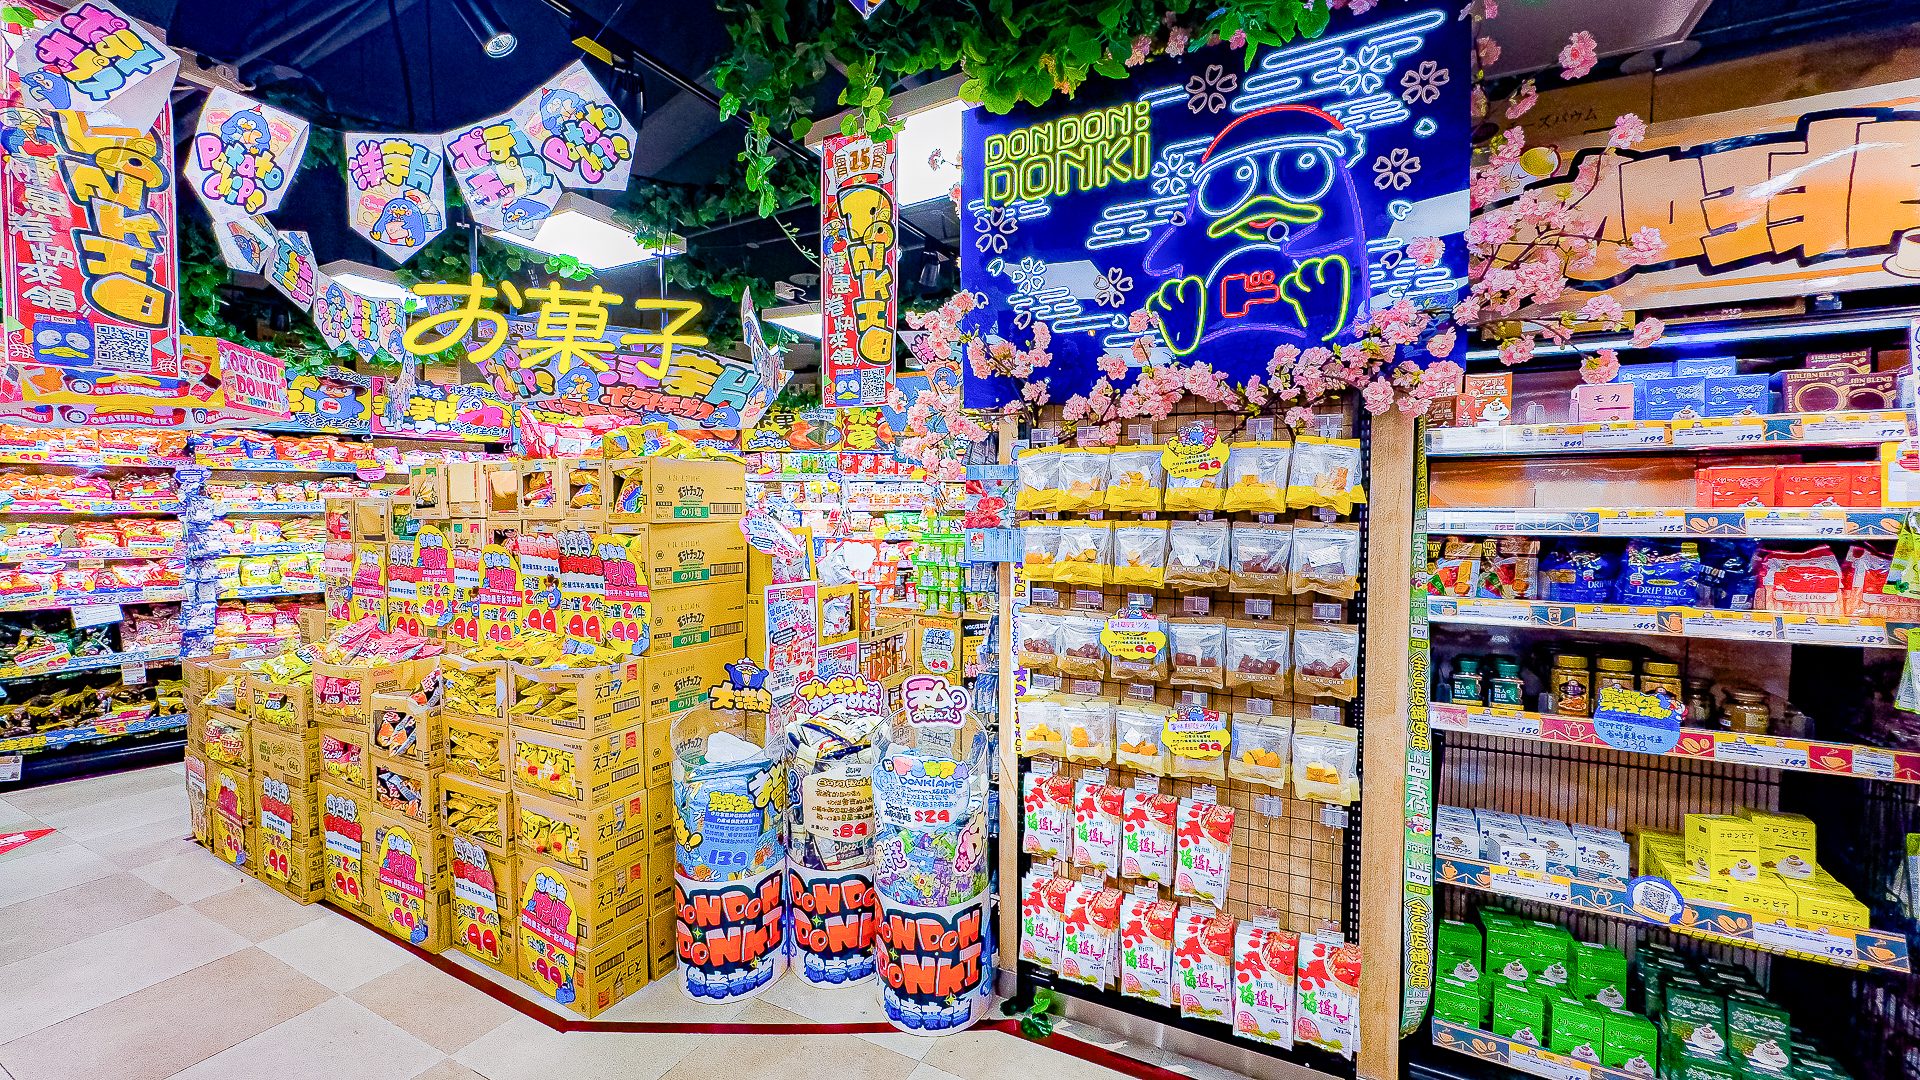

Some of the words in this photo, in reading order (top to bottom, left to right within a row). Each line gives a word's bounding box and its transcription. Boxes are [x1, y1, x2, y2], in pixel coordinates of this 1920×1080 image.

[541, 101, 623, 172] Potato
[195, 132, 285, 191] Potato
[348, 137, 444, 192] 洋芋片
[579, 133, 632, 184] Chips
[849, 147, 870, 172] 15
[983, 131, 1150, 211] DONKI
[201, 172, 266, 213] Chips
[402, 272, 708, 380] お菓子
[229, 352, 278, 381] OKASHI
[1786, 371, 1818, 382] ITALIAN
[1819, 370, 1846, 379] BLEND
[1865, 376, 1893, 385] BLEND
[235, 374, 277, 402] DONKI
[1592, 393, 1621, 403] モカ
[91, 415, 135, 425] OKASHI
[137, 415, 174, 425] DONKI
[1639, 435, 1663, 443] $199
[1736, 433, 1762, 441] $199
[1559, 440, 1583, 448] $249
[677, 486, 705, 499] ポテトチップス
[680, 507, 702, 517] のり塩
[1659, 525, 1684, 533] $155
[1816, 527, 1843, 535] $195
[677, 549, 705, 563] ポテトチップス
[680, 570, 702, 582] のり塩
[1636, 586, 1662, 596] DRIP
[1664, 586, 1687, 596] BAG
[676, 611, 705, 629] ポテトチップス
[1411, 616, 1428, 625] LINE
[1632, 622, 1657, 631] $469
[680, 633, 702, 645] のり塩
[673, 675, 703, 693] ポテトチップス
[1517, 727, 1539, 736] $150
[1407, 753, 1430, 765] LINE
[1411, 766, 1427, 777] Pay
[899, 777, 964, 789] DONKIAME
[914, 809, 950, 823] $29
[832, 822, 868, 838] $89
[1407, 859, 1431, 872] LINE
[1410, 872, 1428, 883] Pay
[721, 874, 782, 922] DON
[788, 873, 842, 915] DON
[843, 879, 875, 912] DO
[1544, 892, 1568, 900] $195
[675, 905, 784, 967] DONKI
[793, 908, 876, 952] DONK
[916, 909, 981, 952] DON
[1824, 946, 1853, 958] $199
[874, 942, 982, 996] DONKI
